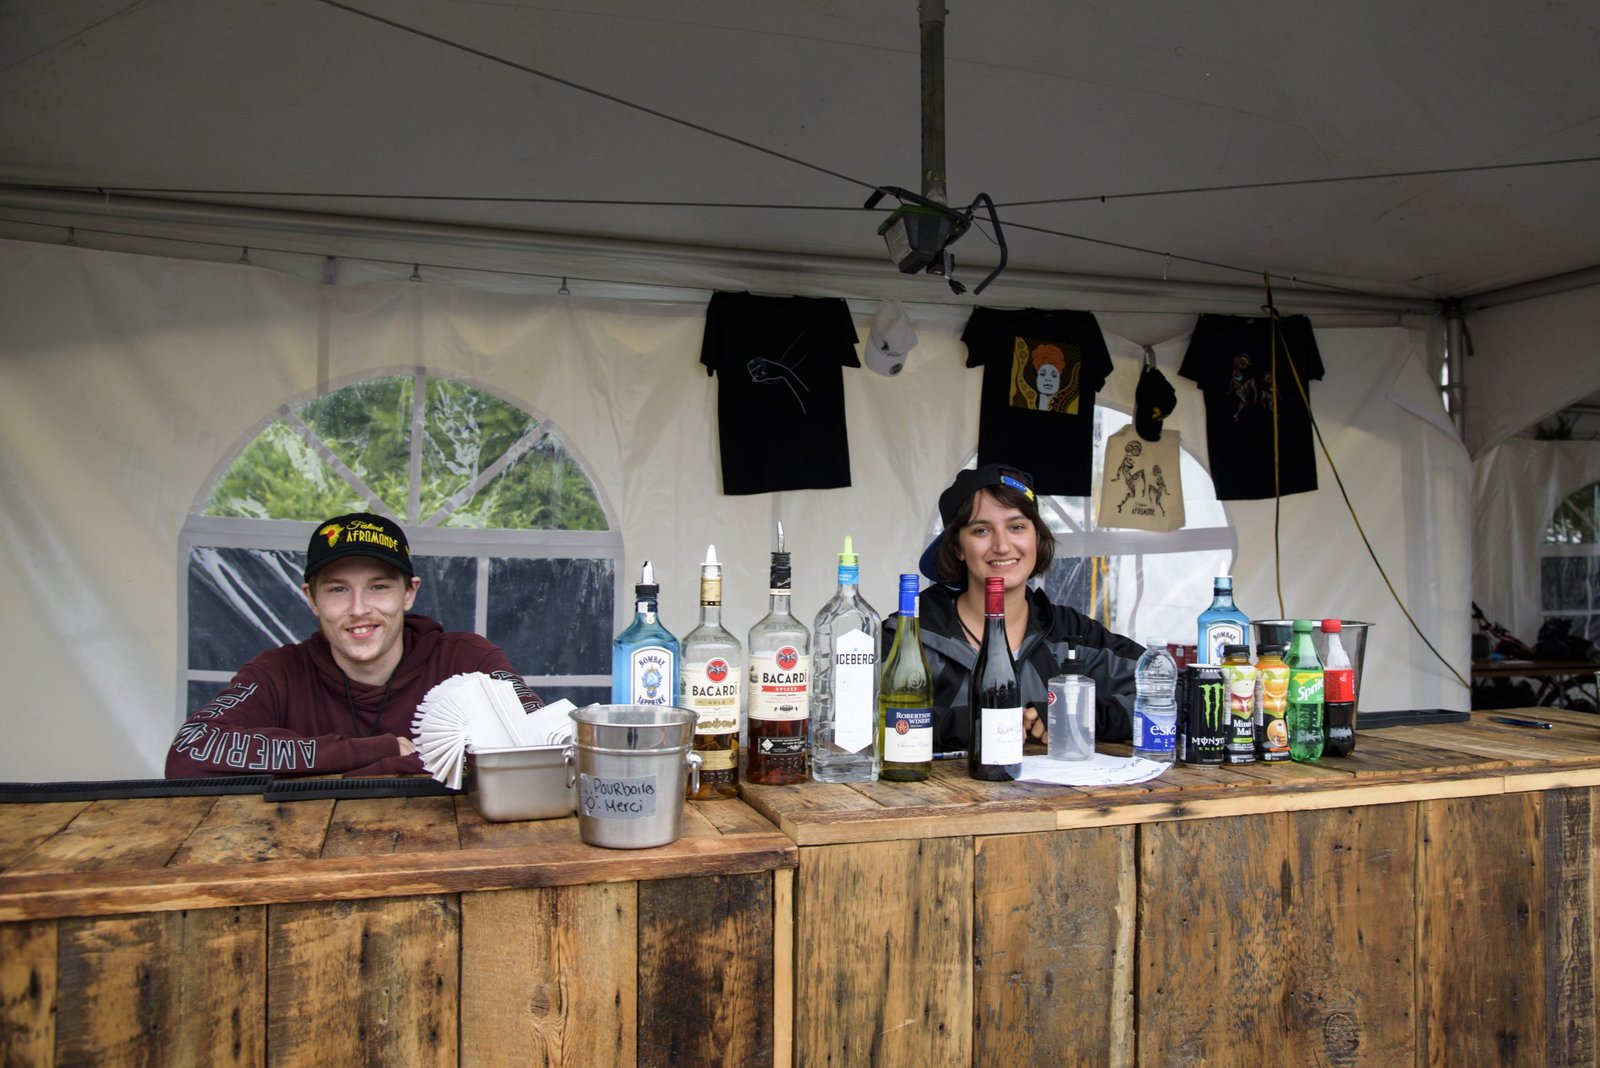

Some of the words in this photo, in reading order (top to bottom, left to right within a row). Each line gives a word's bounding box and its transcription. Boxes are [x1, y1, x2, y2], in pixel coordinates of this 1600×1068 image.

[346, 520, 384, 532] Festival
[346, 530, 399, 552] AFROMONDE
[1212, 631, 1236, 642] BOMBAY
[638, 655, 666, 668] BOMBAY
[836, 653, 875, 665] ICEBERG
[895, 711, 931, 719] ROBERTSON
[604, 799, 643, 813] Merci
